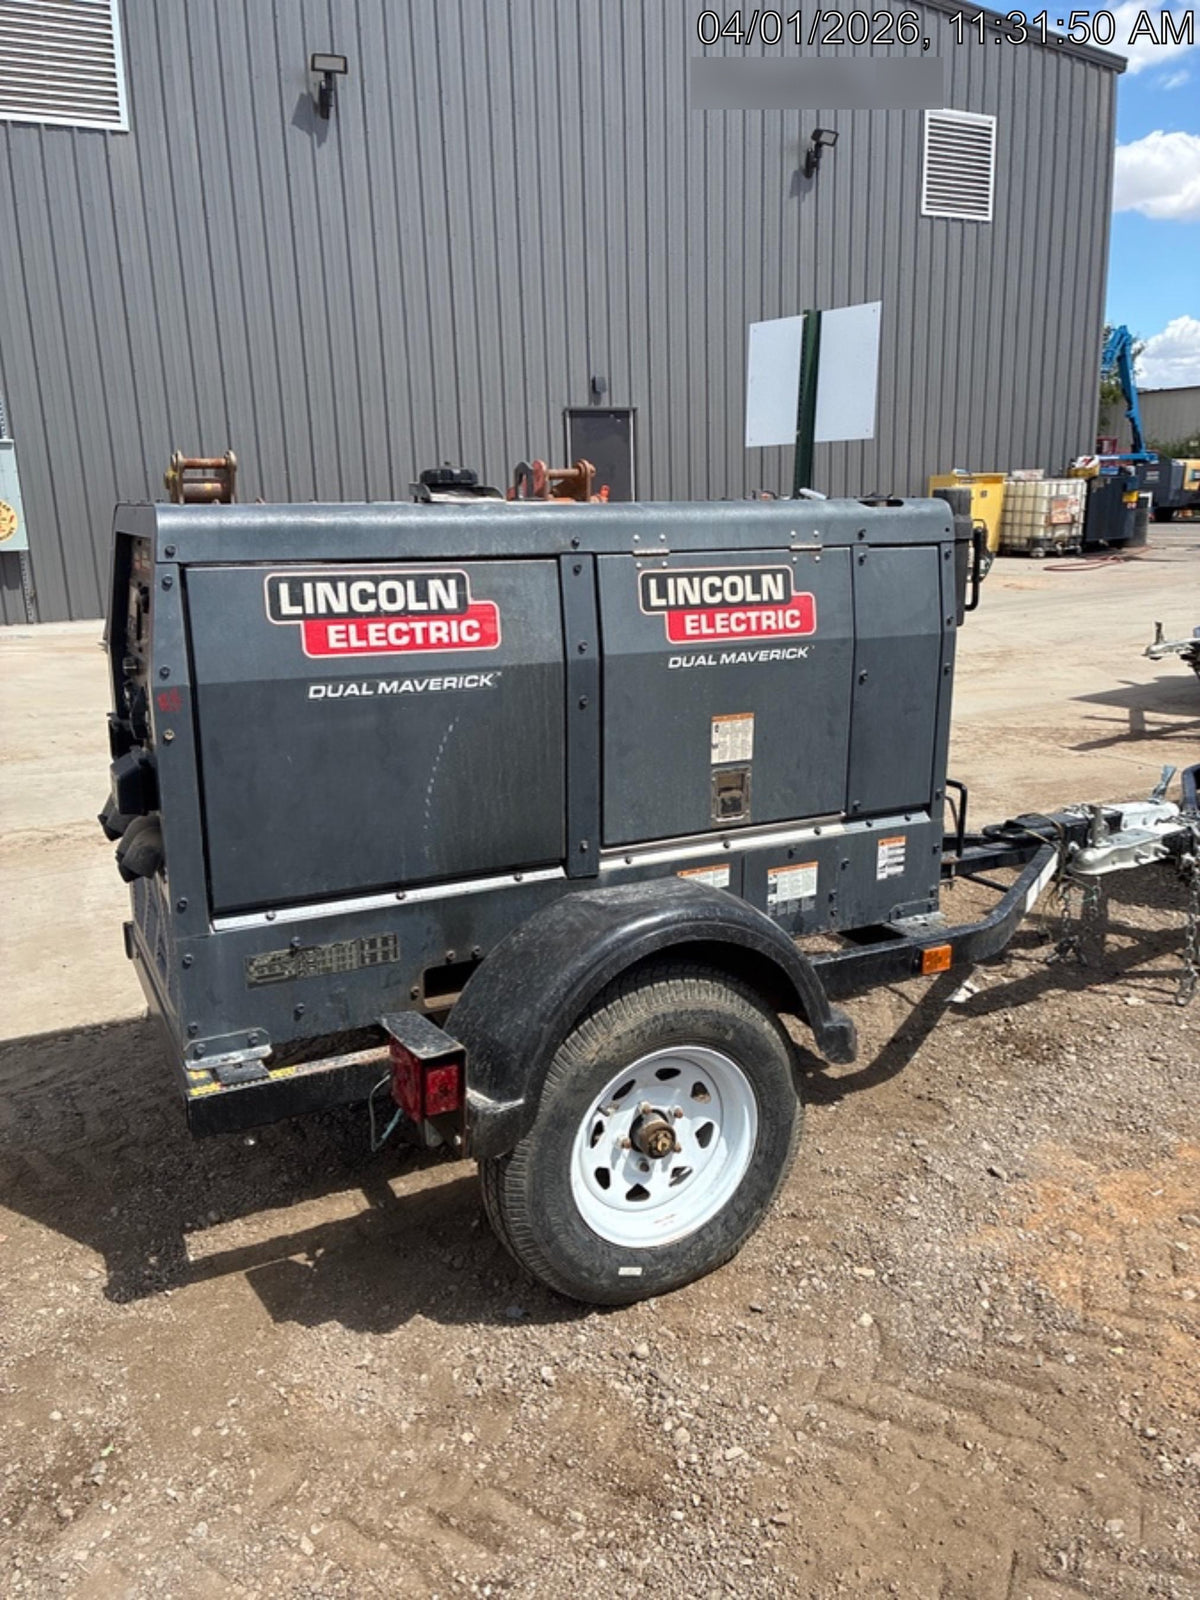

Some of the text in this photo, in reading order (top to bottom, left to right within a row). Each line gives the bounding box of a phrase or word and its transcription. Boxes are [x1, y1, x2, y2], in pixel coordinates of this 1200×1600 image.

[278, 578, 458, 615] LINCOLN
[649, 573, 785, 607] LINCOLN
[327, 619, 481, 649] ELECTRIC
[684, 609, 801, 636] ELECTRIC
[668, 646, 809, 669] DUAL MAVERICK
[308, 673, 494, 699] DUAL MAVERICK
